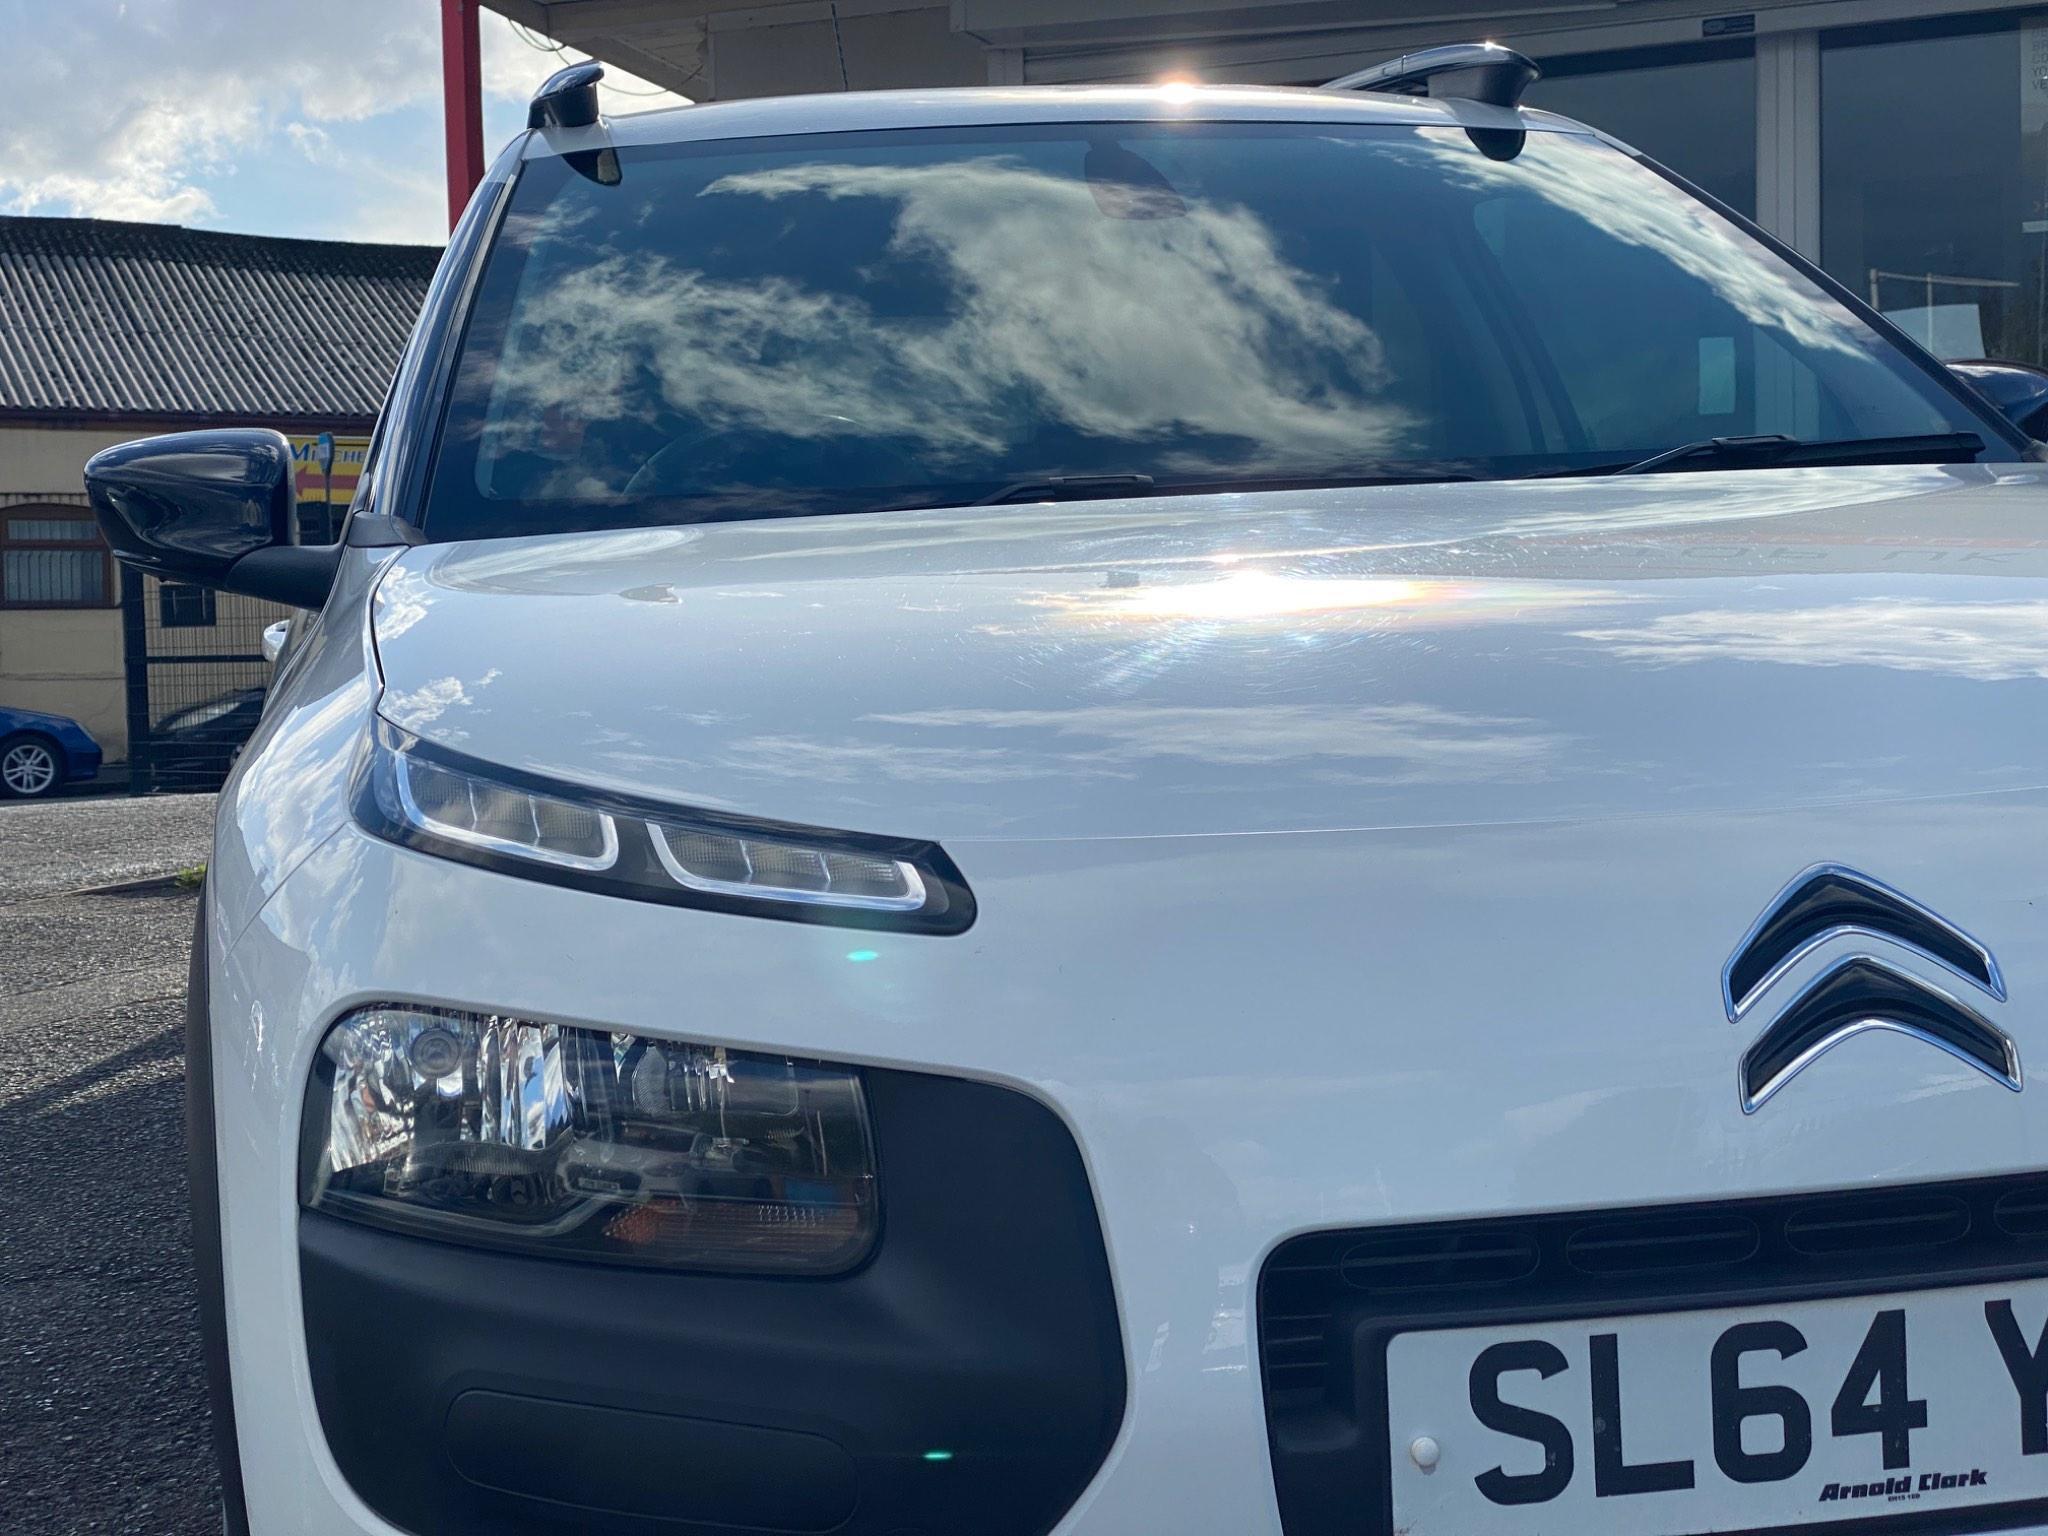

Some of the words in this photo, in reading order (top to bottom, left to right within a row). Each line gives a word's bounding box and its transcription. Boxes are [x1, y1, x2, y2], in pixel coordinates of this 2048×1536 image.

[1469, 1308, 1928, 1505] SL64
[1818, 1475, 1912, 1501] Arnold
[1918, 1468, 1988, 1492] Clark
